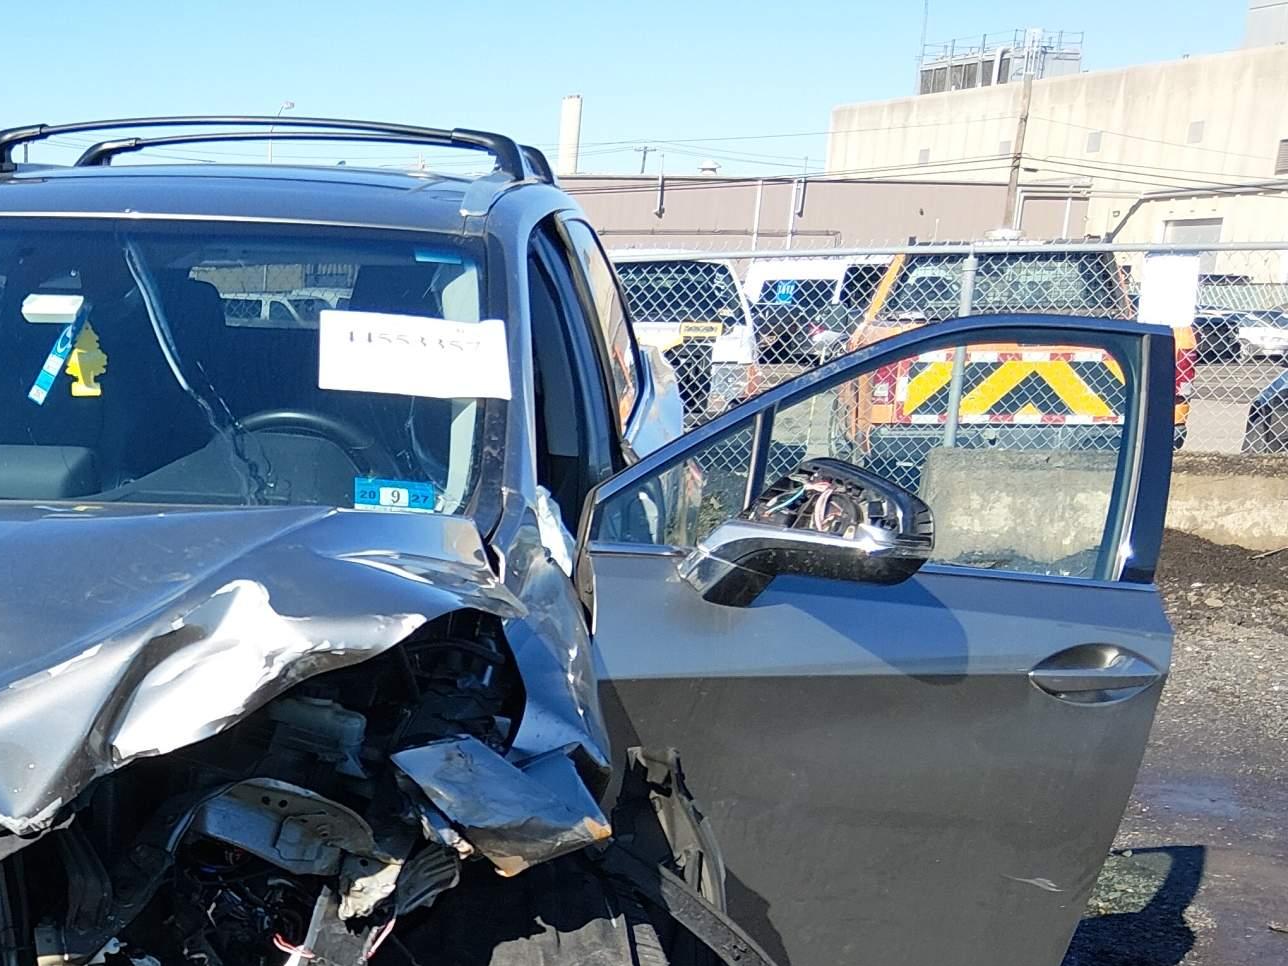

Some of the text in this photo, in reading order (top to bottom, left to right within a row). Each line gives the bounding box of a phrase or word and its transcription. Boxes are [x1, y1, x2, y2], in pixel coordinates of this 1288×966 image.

[359, 489, 430, 505] 20 9 27
